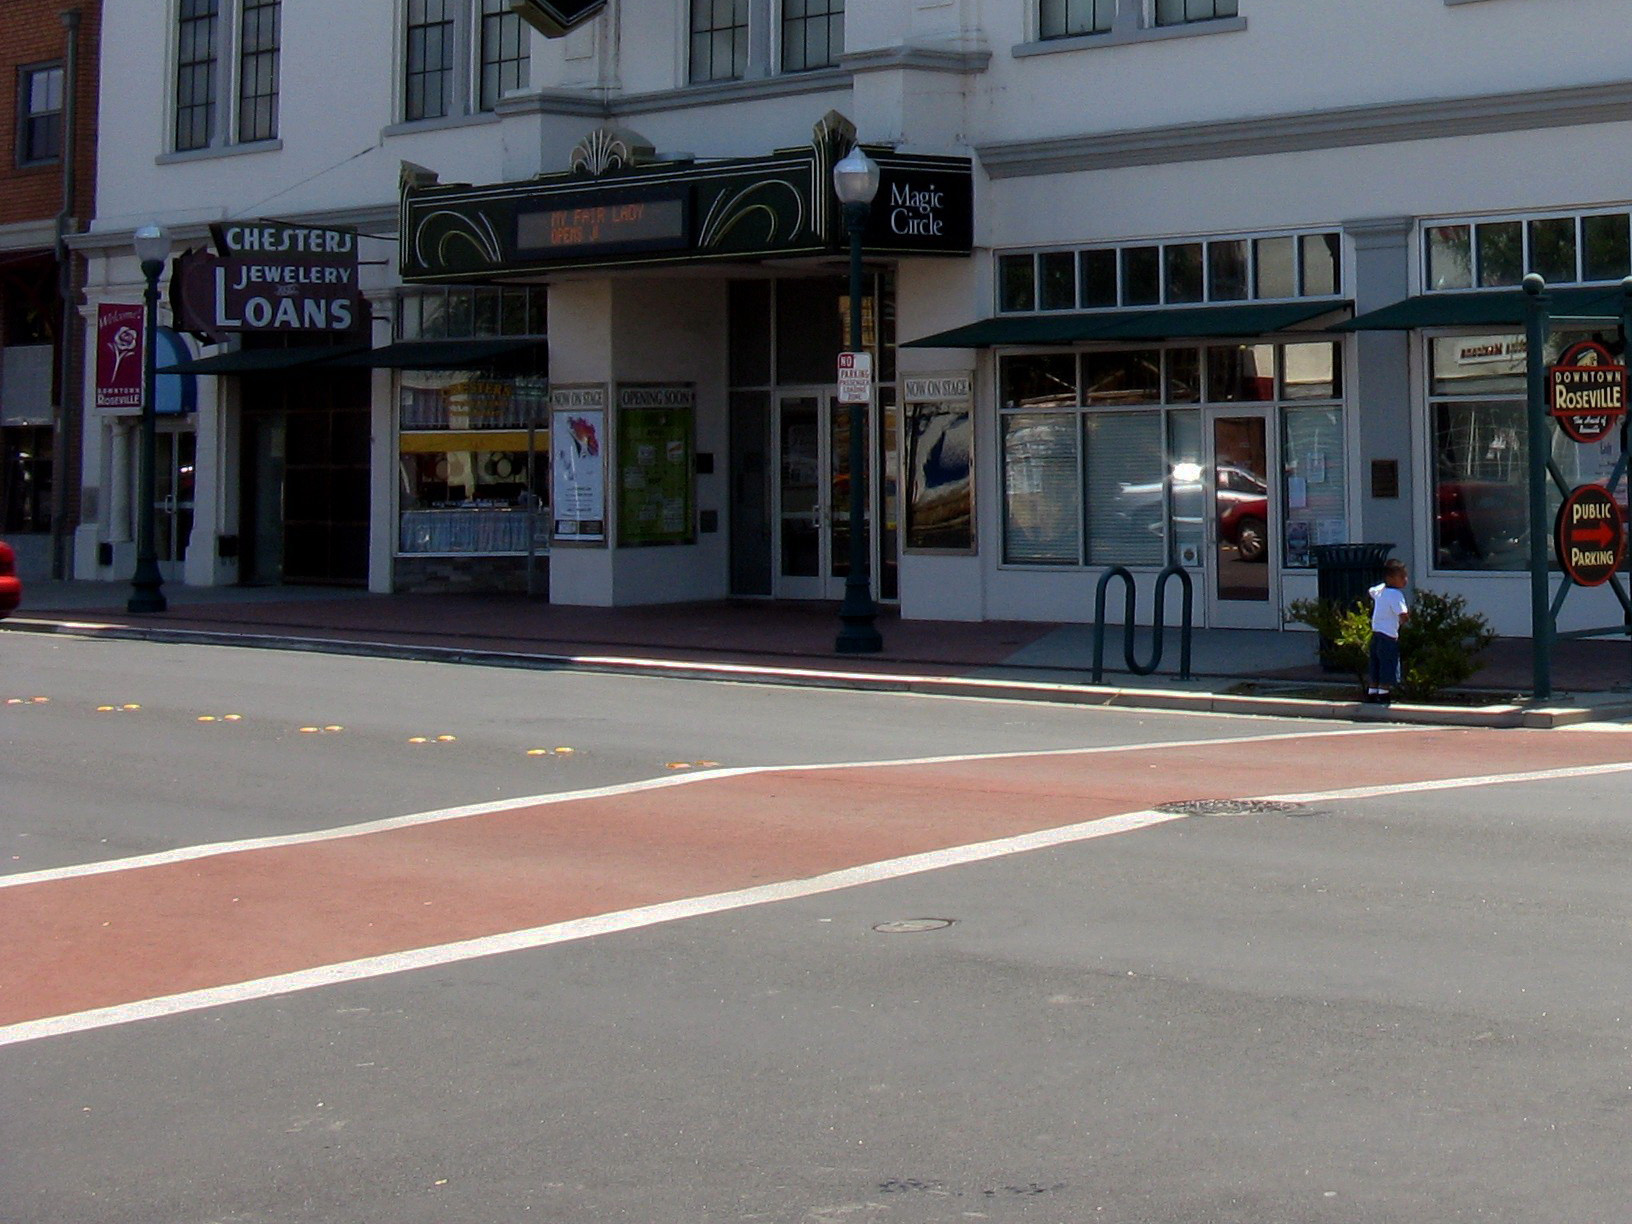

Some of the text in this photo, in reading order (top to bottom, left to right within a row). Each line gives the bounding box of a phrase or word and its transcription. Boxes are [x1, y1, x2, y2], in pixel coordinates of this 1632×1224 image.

[890, 182, 944, 214] Magic
[573, 206, 605, 225] FAIR
[612, 203, 645, 223] LADY
[890, 207, 943, 236] Circle
[226, 227, 352, 252] CHESTERS
[232, 265, 352, 290] JEWELERY
[214, 266, 352, 330] LOANS
[840, 355, 852, 367] NO
[905, 379, 968, 397] NOW ON STAGE
[1555, 371, 1621, 383] DOWNTOWN
[622, 389, 690, 406] OPENING SOON
[1555, 384, 1622, 409] ROSEVILLE
[1572, 503, 1612, 524] PUBLIC
[1571, 547, 1614, 567] PARKING
